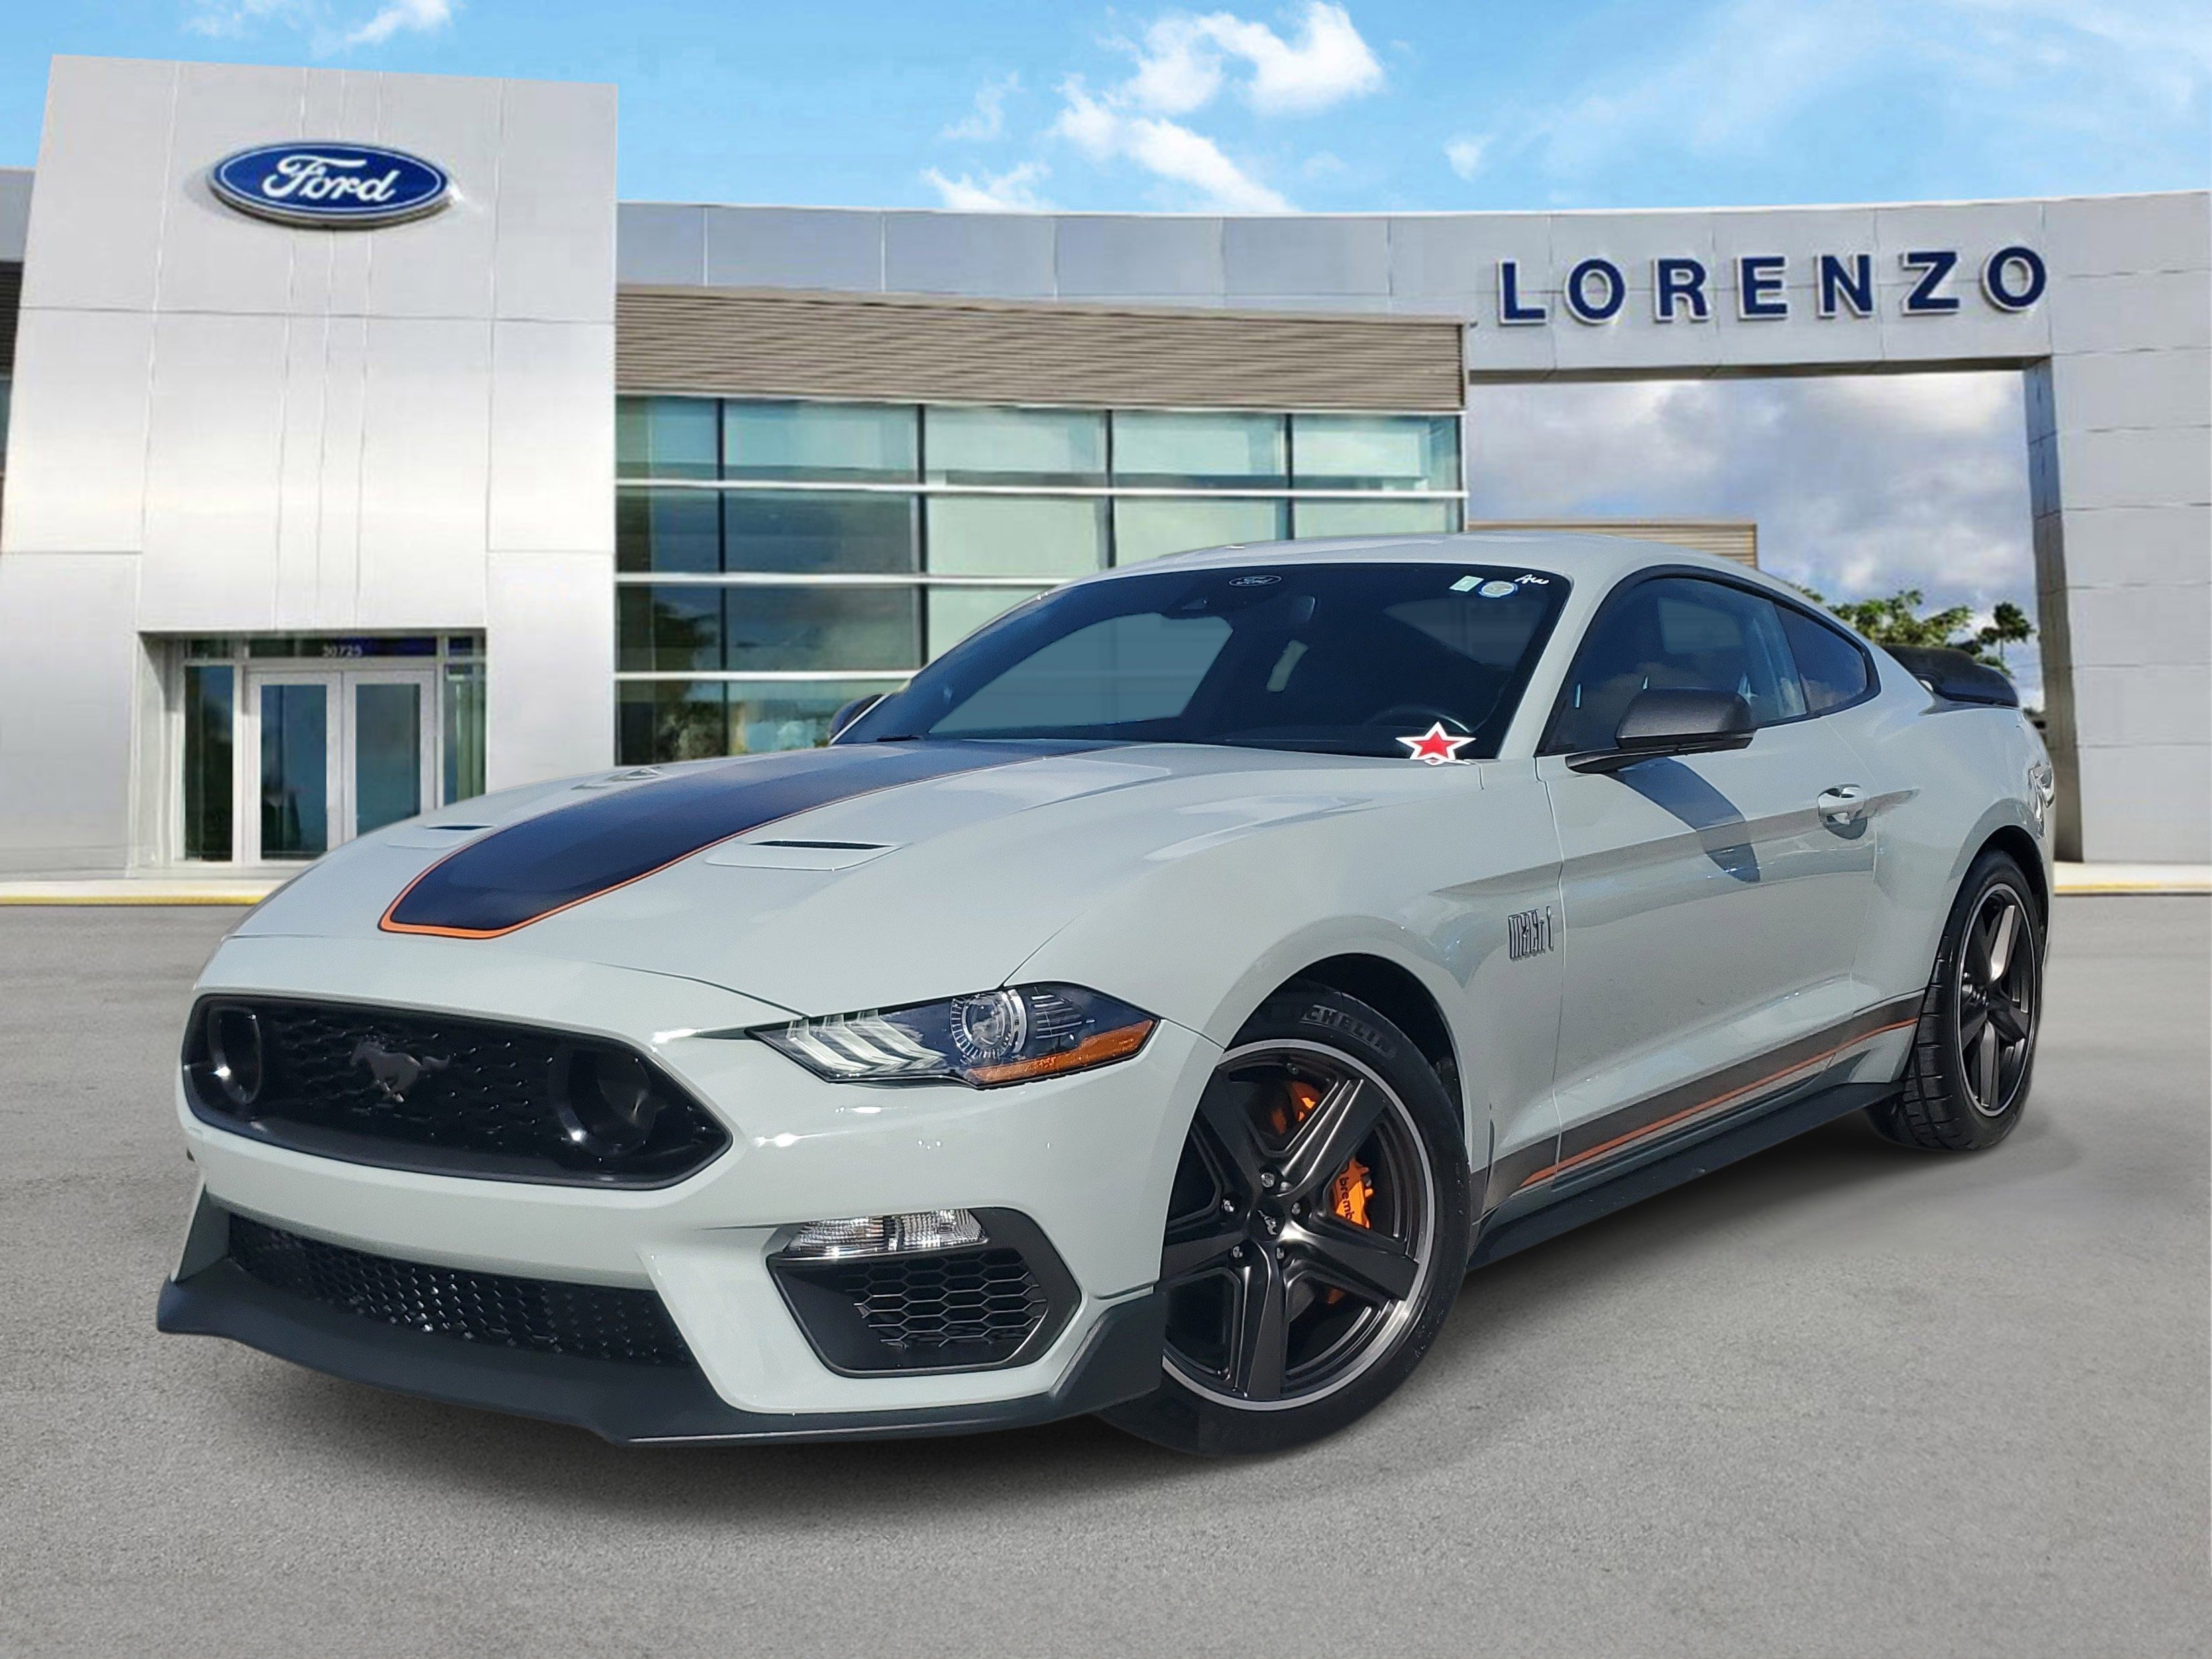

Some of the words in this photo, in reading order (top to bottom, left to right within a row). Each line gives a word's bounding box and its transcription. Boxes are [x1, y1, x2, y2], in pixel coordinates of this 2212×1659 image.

[262, 154, 400, 201] Ford
[1498, 246, 2046, 323] LORENZO
[1305, 1004, 1392, 1053] CHELIN
[1339, 1176, 1355, 1219] bremb
